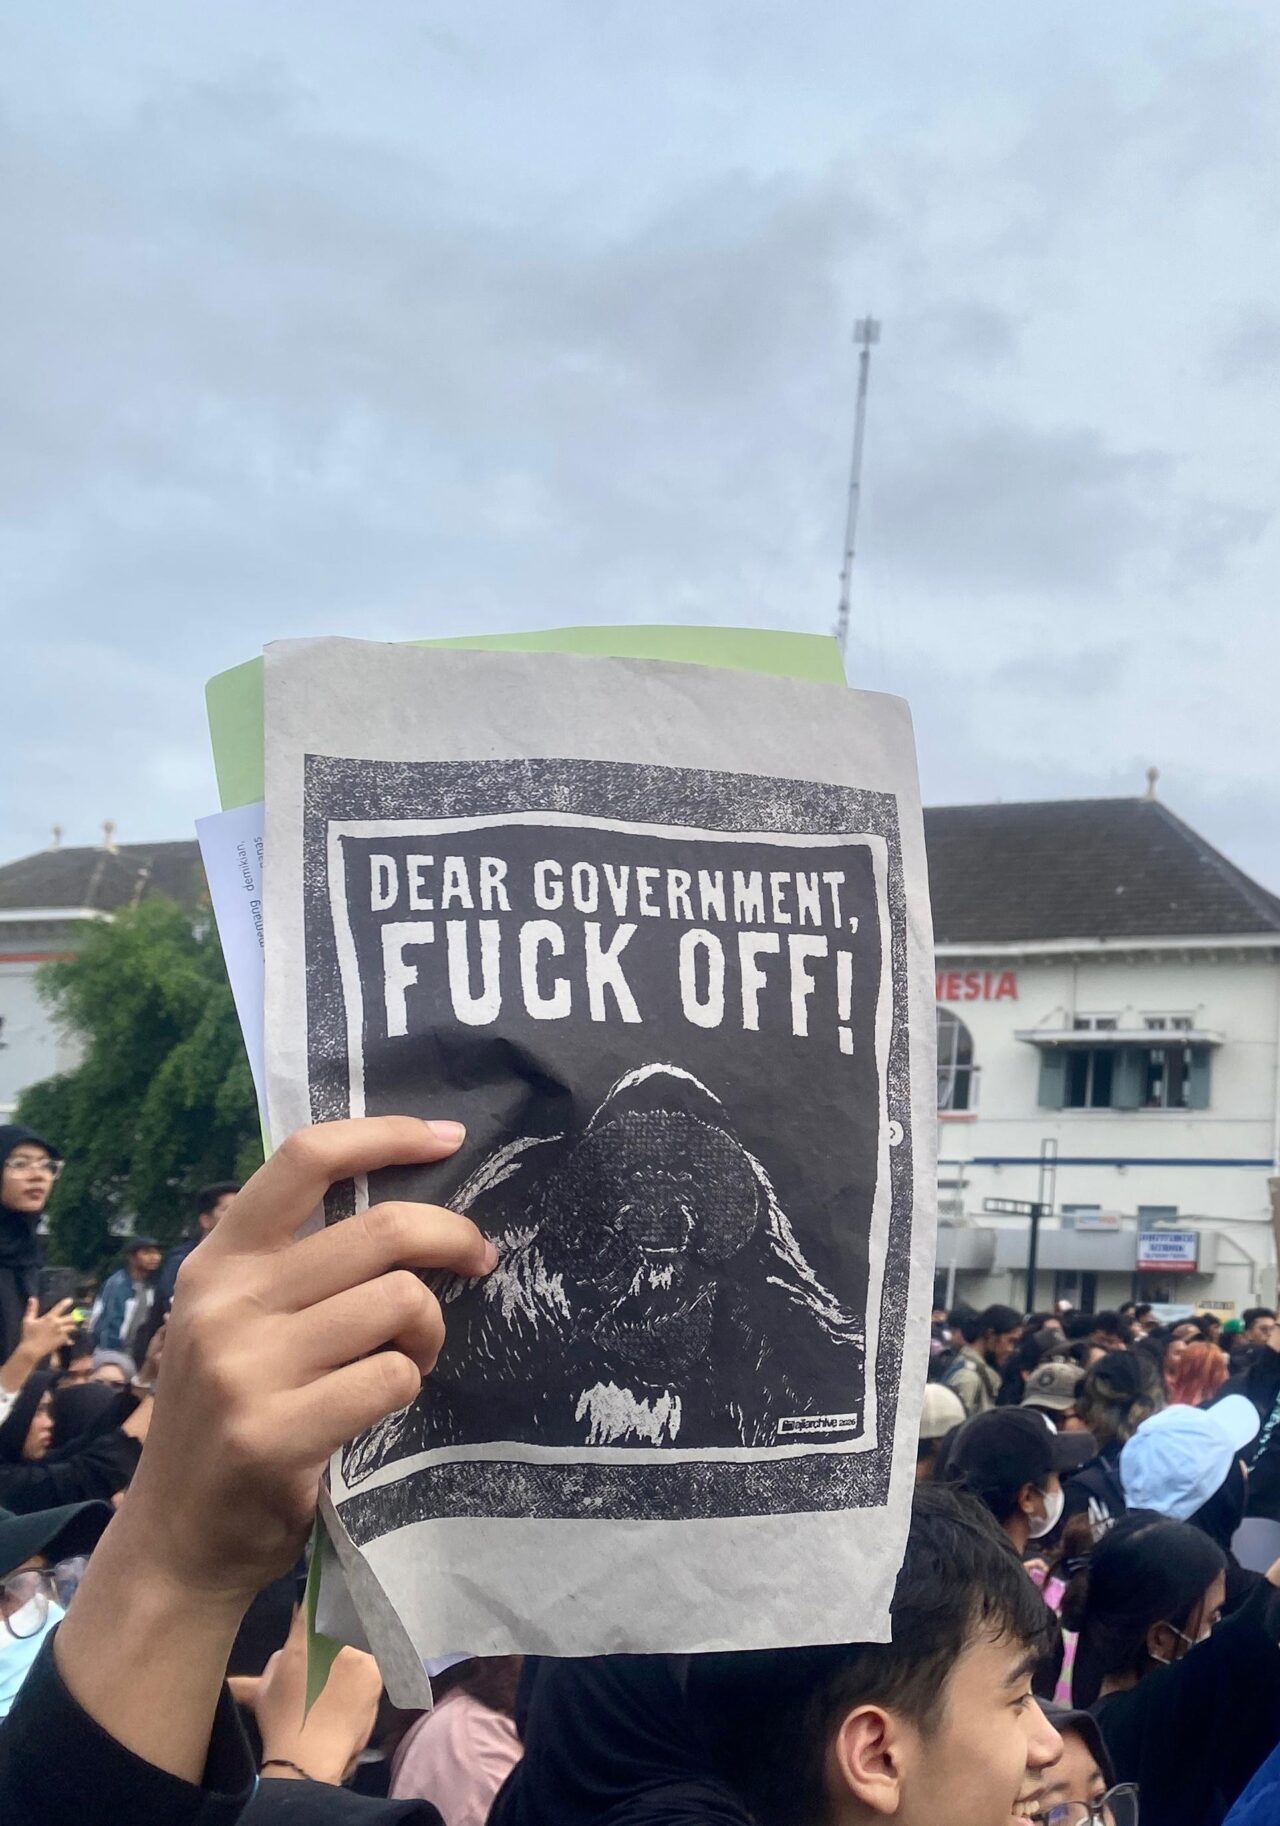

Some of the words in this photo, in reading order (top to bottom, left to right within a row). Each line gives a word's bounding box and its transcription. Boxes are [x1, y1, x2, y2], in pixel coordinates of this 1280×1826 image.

[237, 841, 255, 891] demikian,
[369, 853, 511, 912] DEAR
[533, 858, 860, 934] GOVERNMENT,
[380, 919, 643, 1038] FUCK
[678, 927, 854, 1055] OFF!
